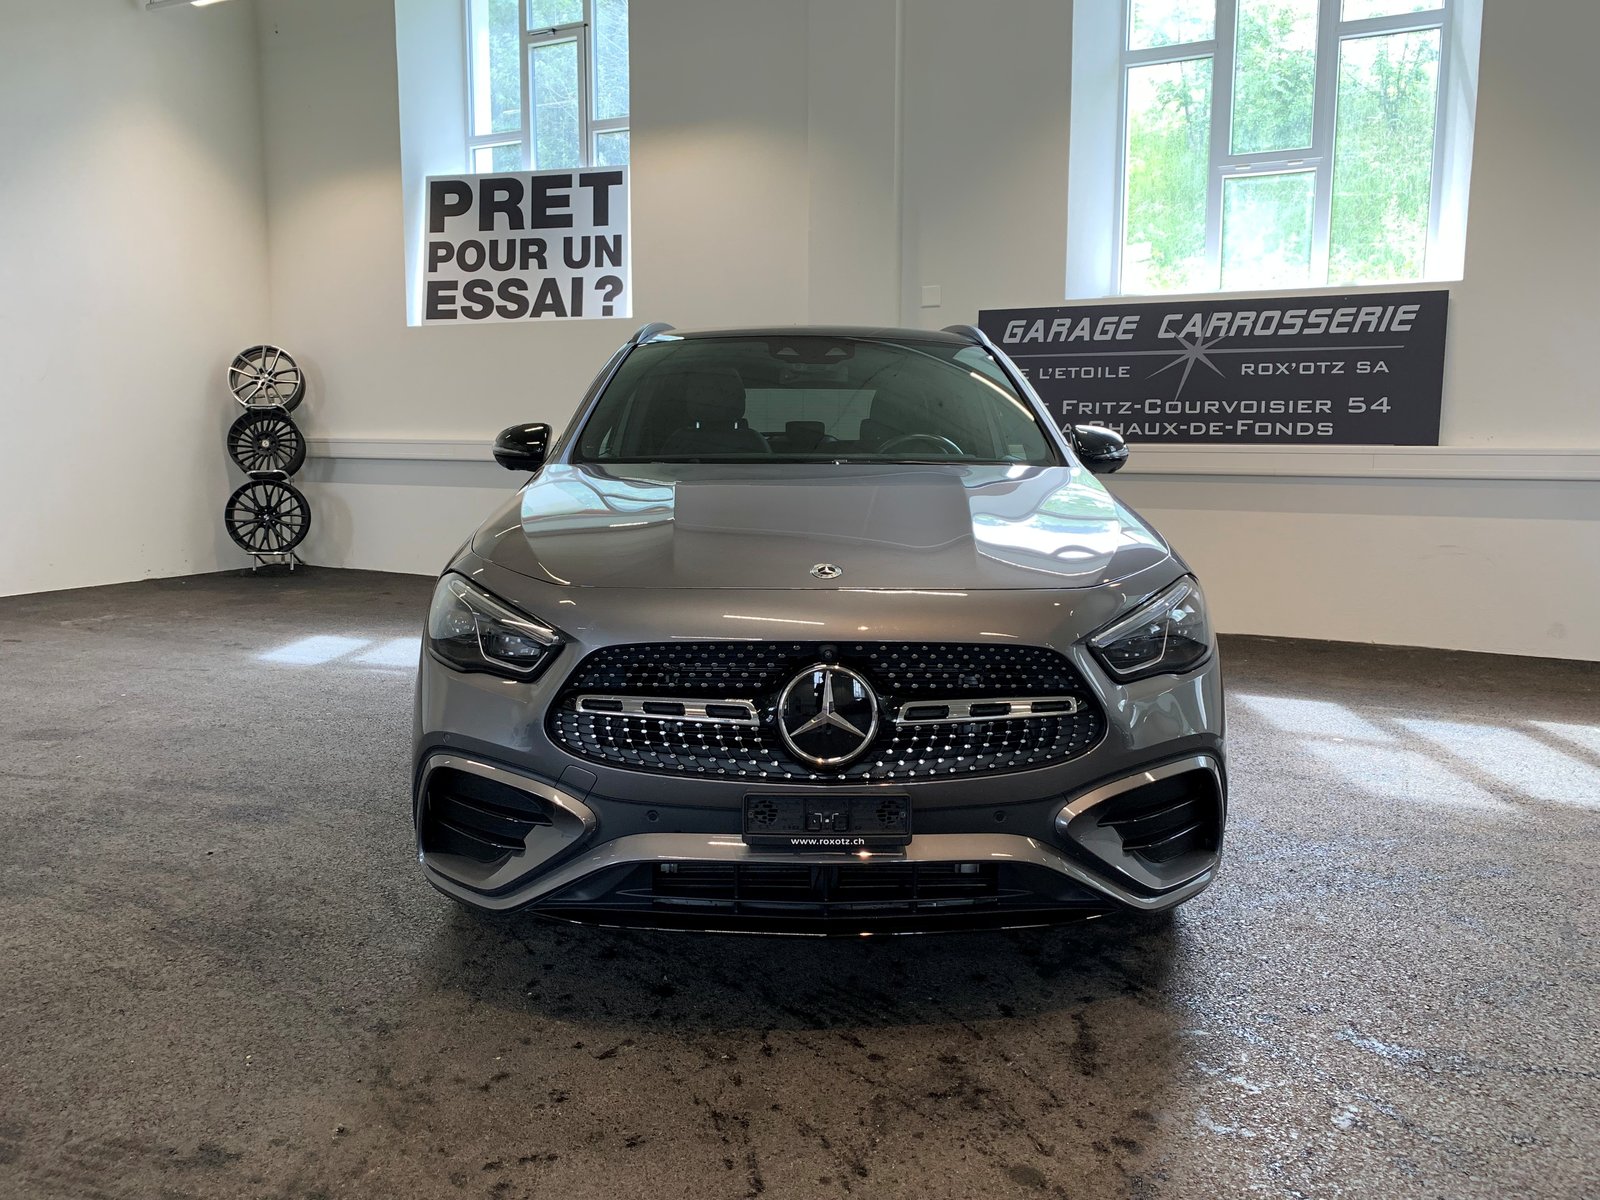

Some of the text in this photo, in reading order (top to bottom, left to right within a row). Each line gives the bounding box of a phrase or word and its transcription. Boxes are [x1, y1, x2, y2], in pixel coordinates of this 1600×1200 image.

[430, 171, 623, 233] PRET
[428, 234, 622, 273] POUR UN
[1002, 304, 1421, 344] GARAGE CARROSSERIE
[1039, 366, 1131, 379] L'ETOILE
[1241, 361, 1345, 376] ROX'OTZ
[1356, 360, 1390, 374] SA
[1062, 396, 1392, 415] FRITZ-COURVOISIER 54
[790, 837, 865, 846] www.roxotz.ch
